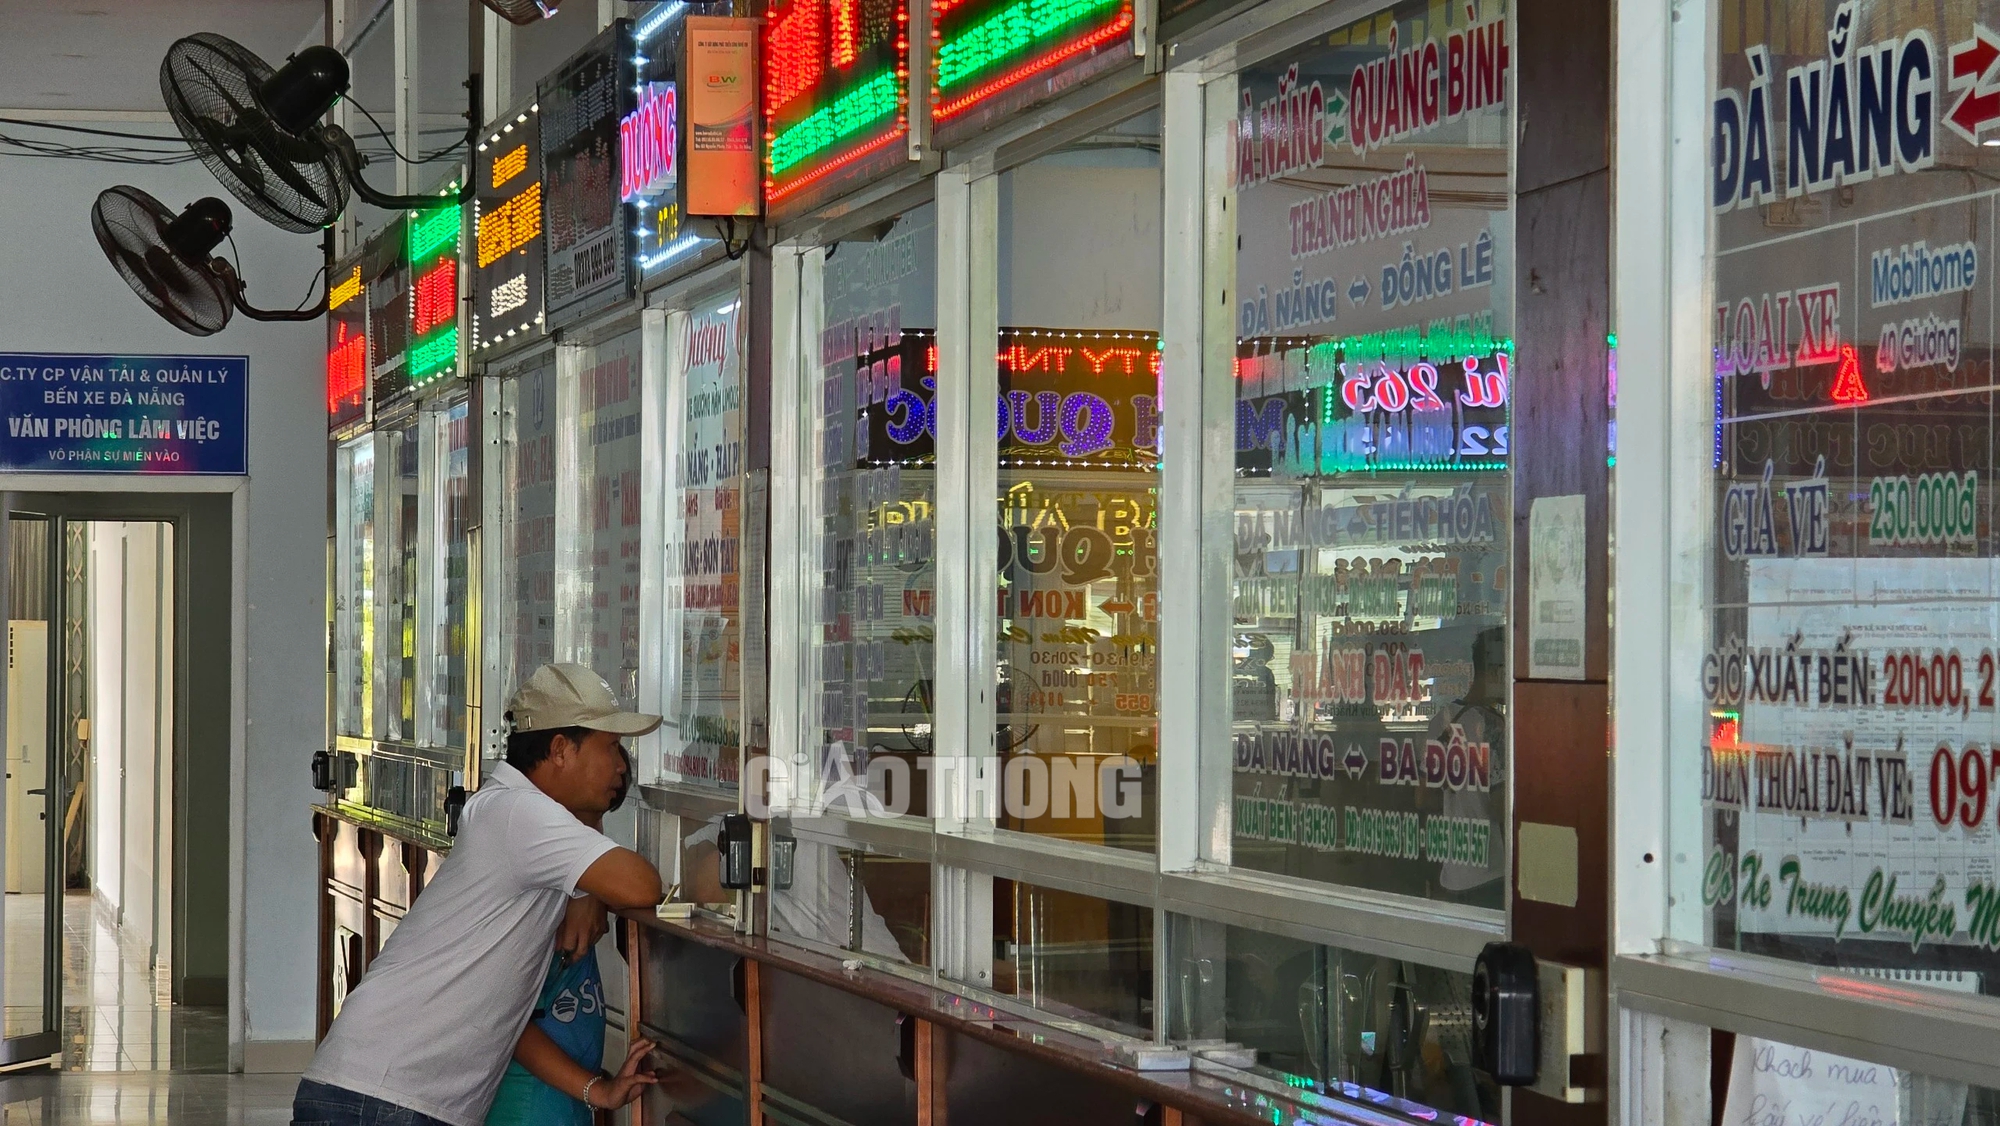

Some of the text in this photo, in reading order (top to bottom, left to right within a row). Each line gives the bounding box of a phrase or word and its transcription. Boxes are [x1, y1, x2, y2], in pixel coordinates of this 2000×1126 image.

[1350, 20, 1439, 163] QUẢNG
[1289, 149, 1431, 260] THANH NGHĨA
[1242, 228, 1492, 341] ĐÀ NẴNG ĐỒNG LÊ
[1872, 240, 1977, 308] Mobihome
[1716, 283, 1840, 389] LOẠI XE
[1877, 312, 1960, 374] 40 Giường
[42, 368, 65, 381] CP
[72, 365, 104, 384] VẬN
[108, 363, 135, 382] TẢI
[156, 364, 203, 384] QUẢN
[207, 367, 229, 384] LÝ
[44, 386, 78, 404] BẾN
[83, 391, 105, 405] XE
[110, 388, 134, 405] ĐÀ
[8, 413, 220, 444] VĂN PHÒNG LÀM VIỆC
[48, 447, 66, 460] VÔ
[69, 447, 100, 462] PHẬN
[103, 449, 120, 463] SỰ
[155, 448, 180, 461] VÀO
[1722, 459, 1778, 561] GIÁ
[1870, 470, 1977, 544] 250.000đ
[1748, 628, 1811, 706] XUẤT
[1978, 654, 2000, 706] 2
[1237, 722, 1265, 772] ĐÀ
[1380, 738, 1420, 785] BA
[1425, 724, 1490, 791] ĐỒN
[1740, 849, 1772, 910] Xe
[1780, 855, 1852, 942] Trung
[1859, 866, 1957, 953] Chuyển
